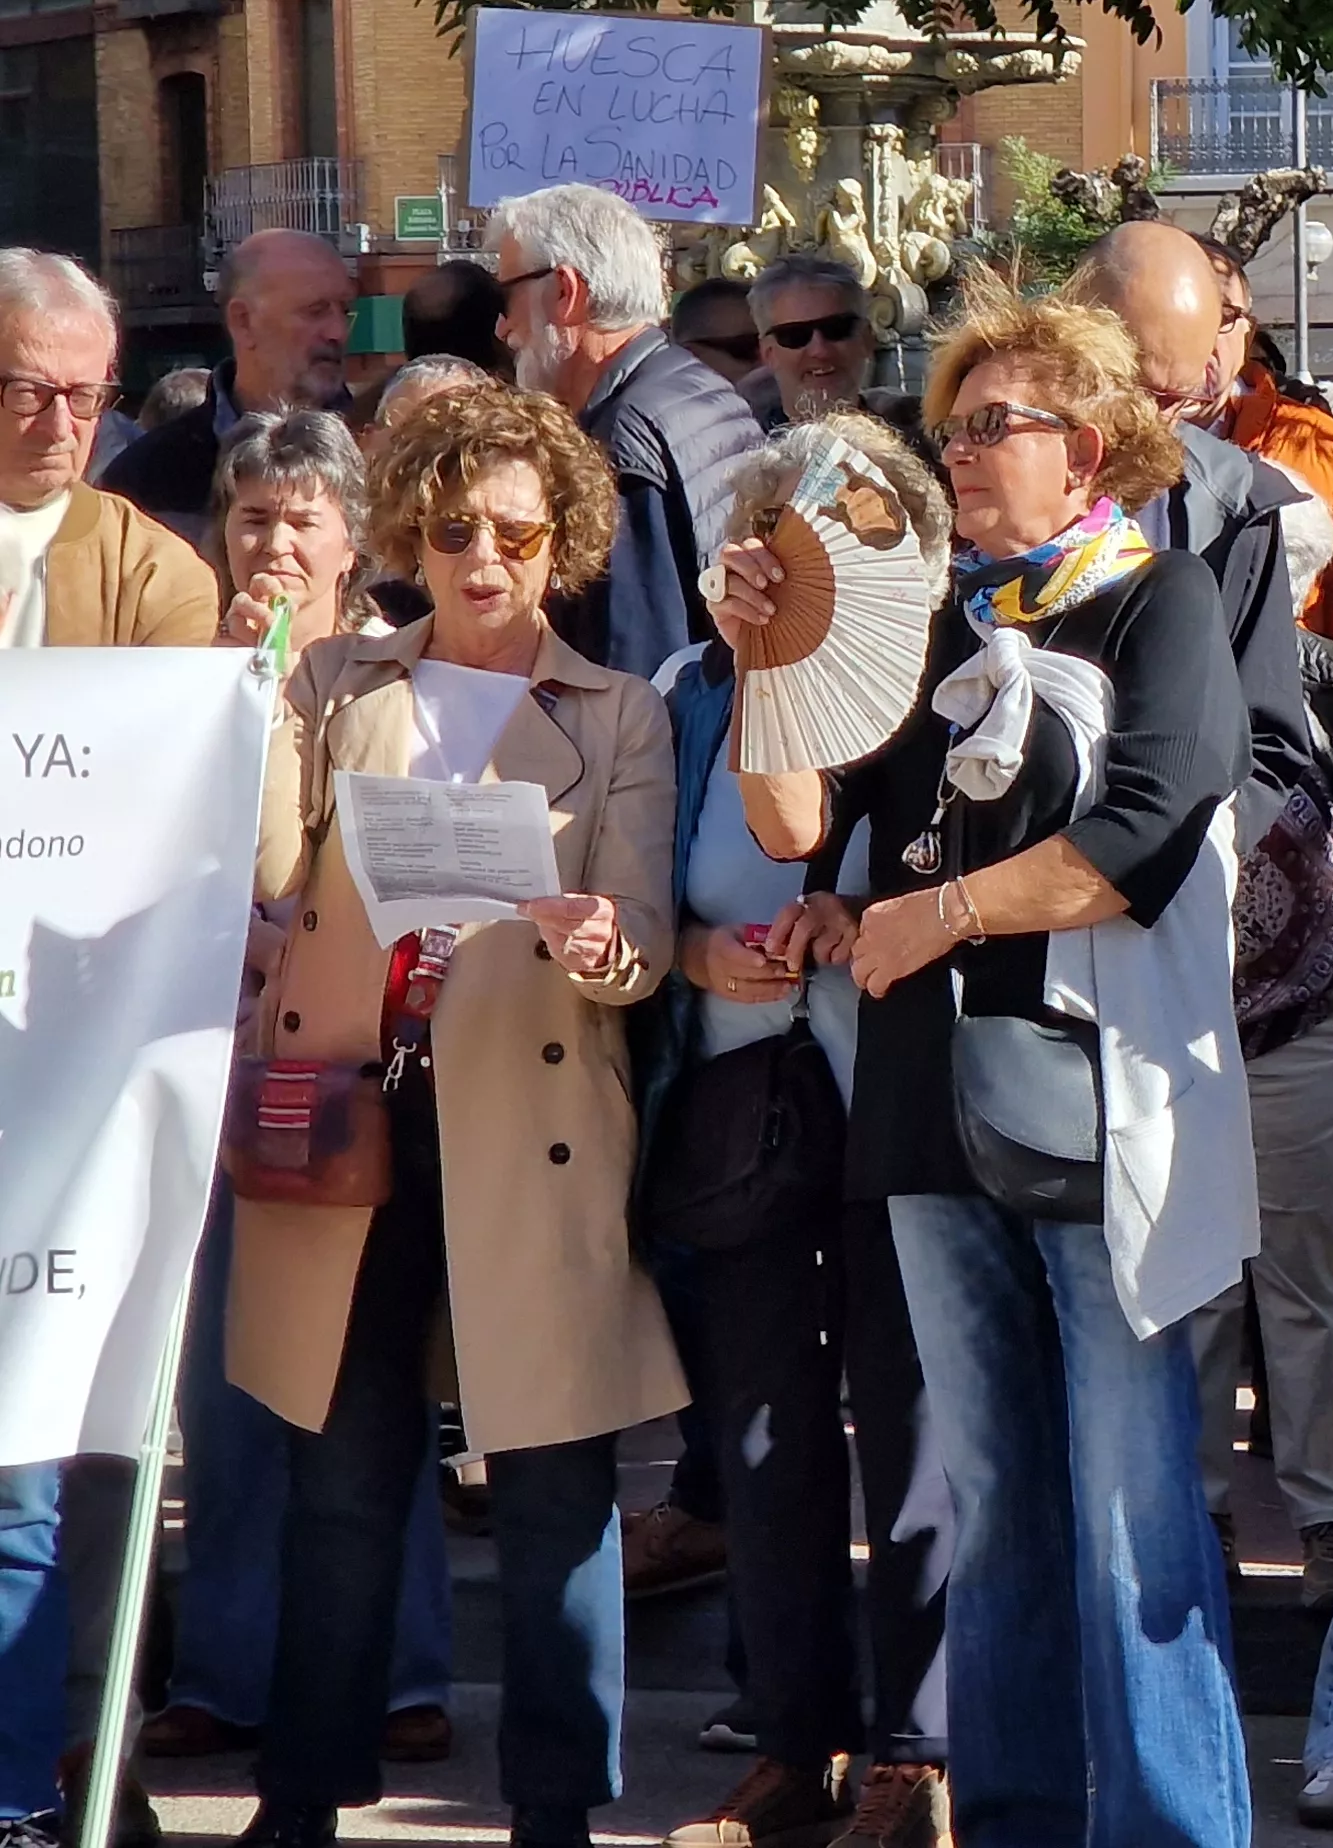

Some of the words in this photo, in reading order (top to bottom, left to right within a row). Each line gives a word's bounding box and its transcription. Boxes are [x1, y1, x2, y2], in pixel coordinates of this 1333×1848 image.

[506, 28, 736, 85] HUESCA
[533, 81, 585, 117] EN
[608, 86, 735, 125] LUCHA
[541, 134, 577, 179] LA
[584, 126, 737, 190] SANIDAD
[12, 733, 91, 778] YA:
[0, 829, 84, 858] dono
[0, 1249, 85, 1299] DE,
